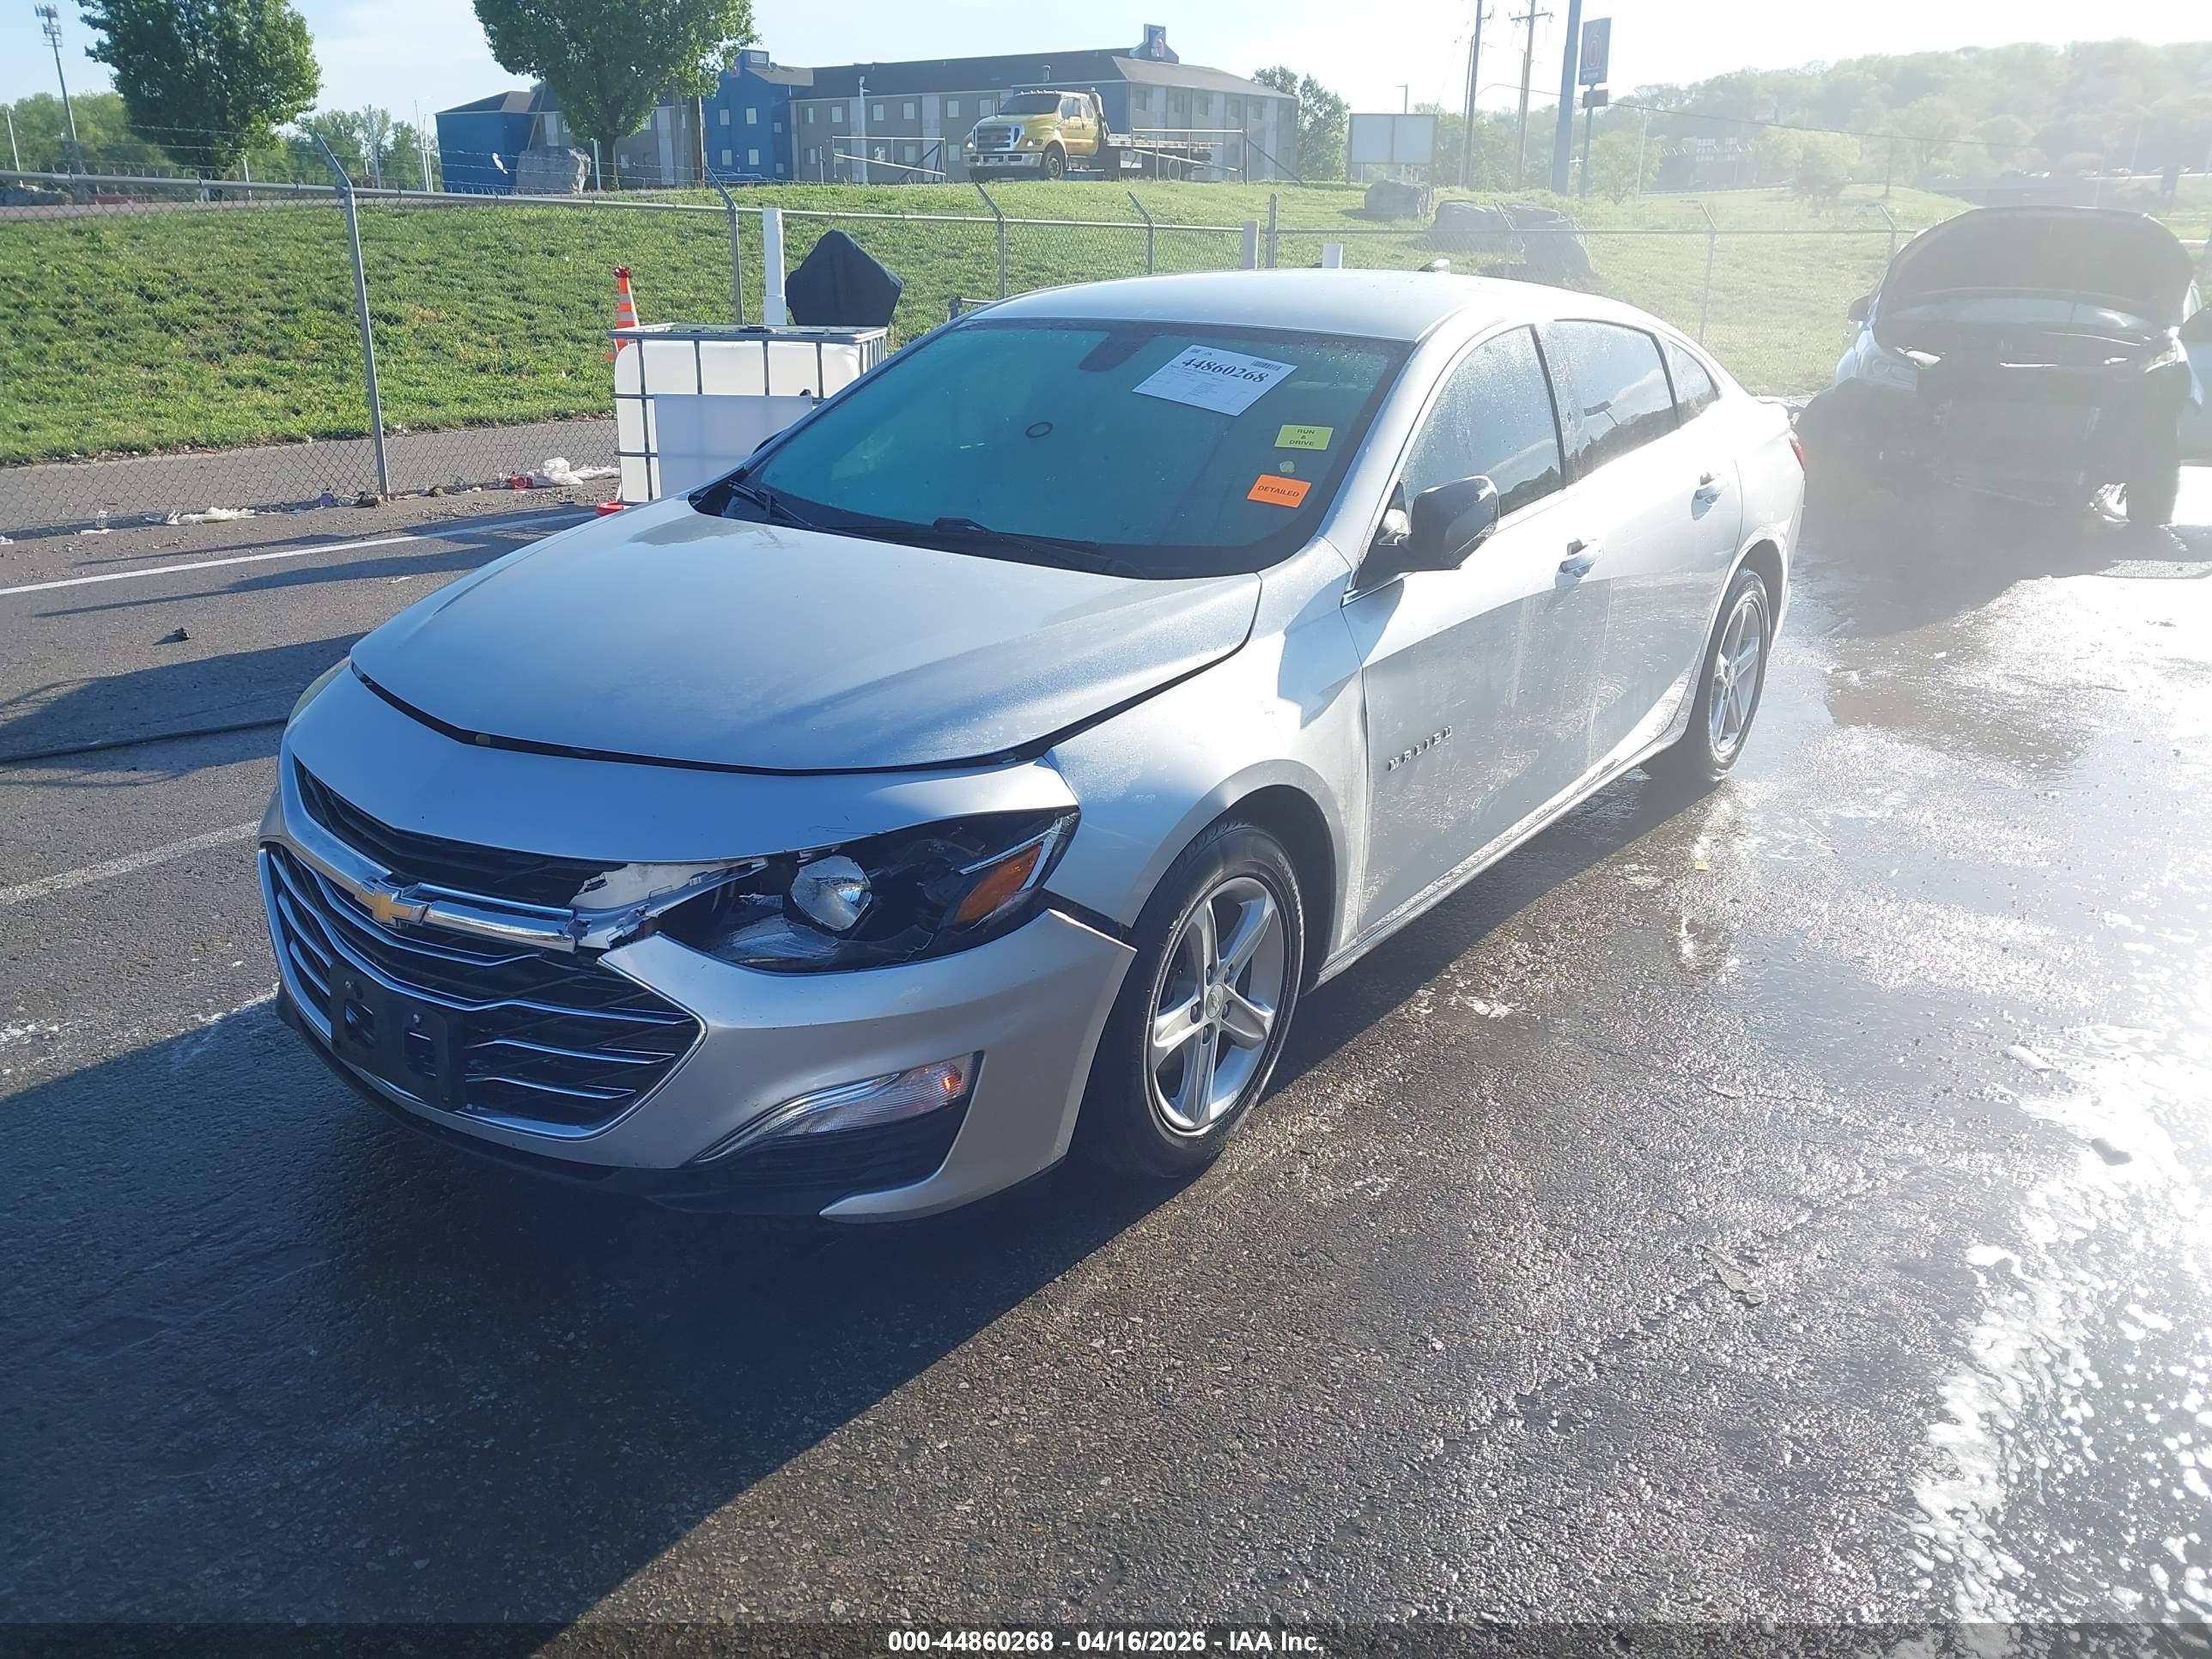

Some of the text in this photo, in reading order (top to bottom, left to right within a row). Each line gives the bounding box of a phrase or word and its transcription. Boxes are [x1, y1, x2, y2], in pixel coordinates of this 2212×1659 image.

[1182, 357, 1269, 383] 44860268
[1257, 485, 1299, 497] DETAILED
[1388, 726, 1452, 772] MALIBU
